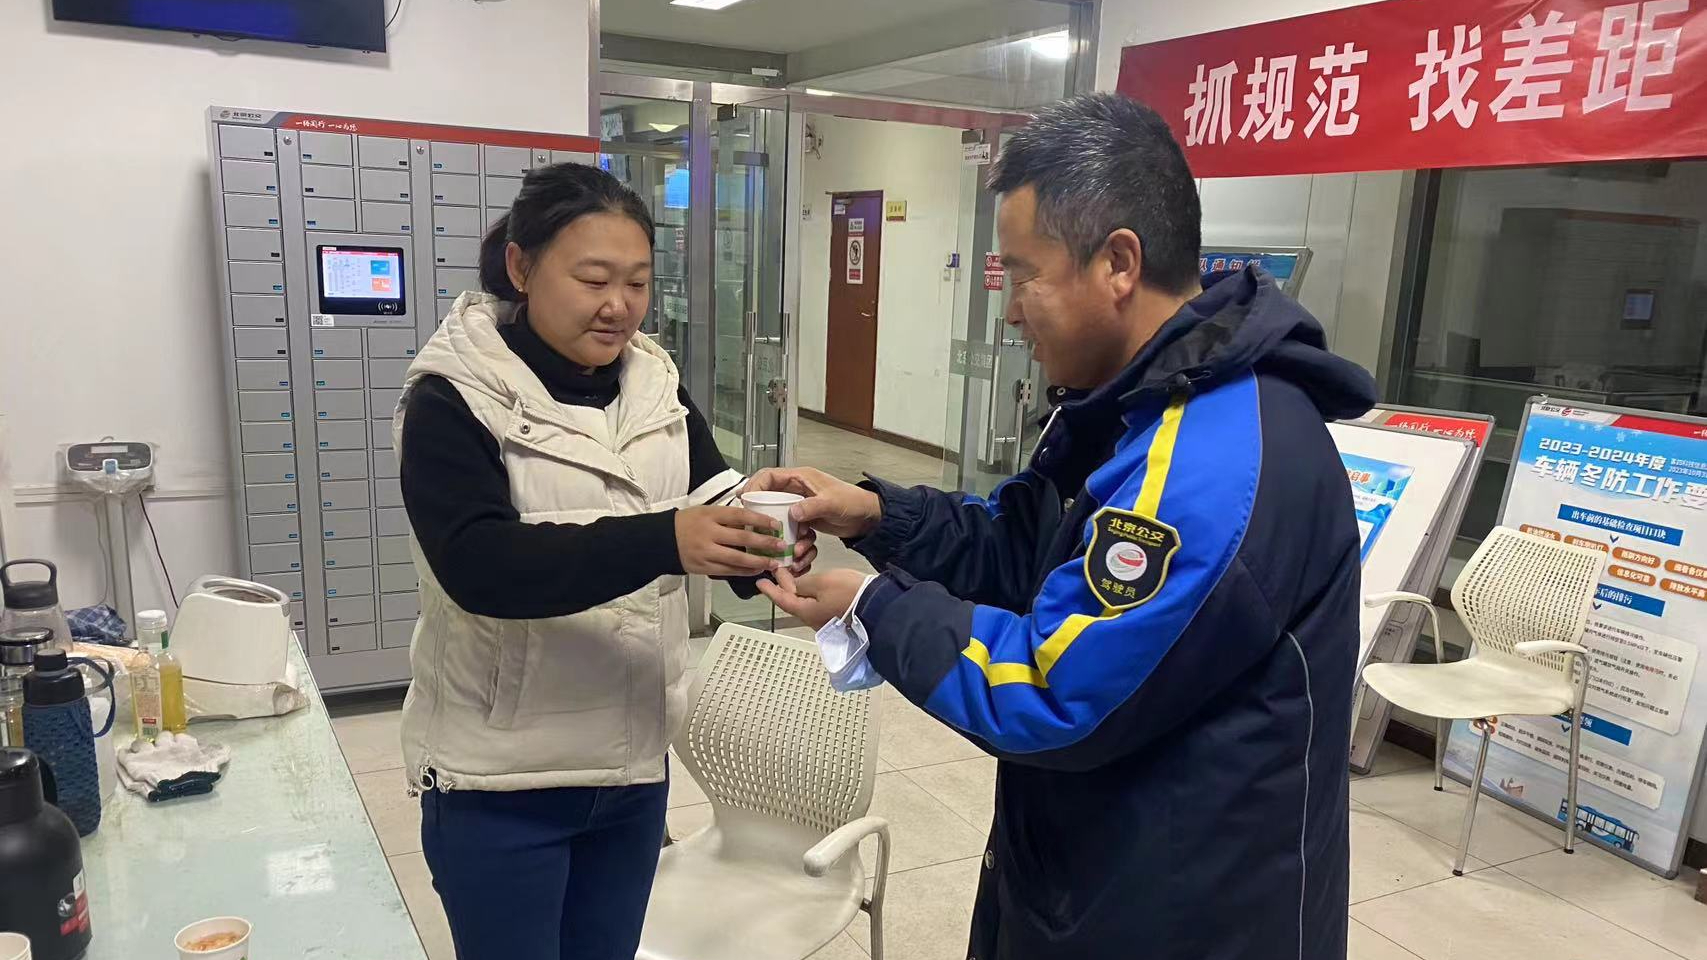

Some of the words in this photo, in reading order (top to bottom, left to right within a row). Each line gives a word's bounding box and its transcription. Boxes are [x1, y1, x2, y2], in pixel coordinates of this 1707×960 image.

[1183, 42, 1369, 147] 抓规范
[1407, 0, 1690, 133] 找差距
[1538, 437, 1668, 472] 2023-2024年度
[1530, 454, 1707, 510] 车辆冬防工作要
[1108, 518, 1166, 543] 北京公交
[1100, 578, 1136, 599] 驾驶员
